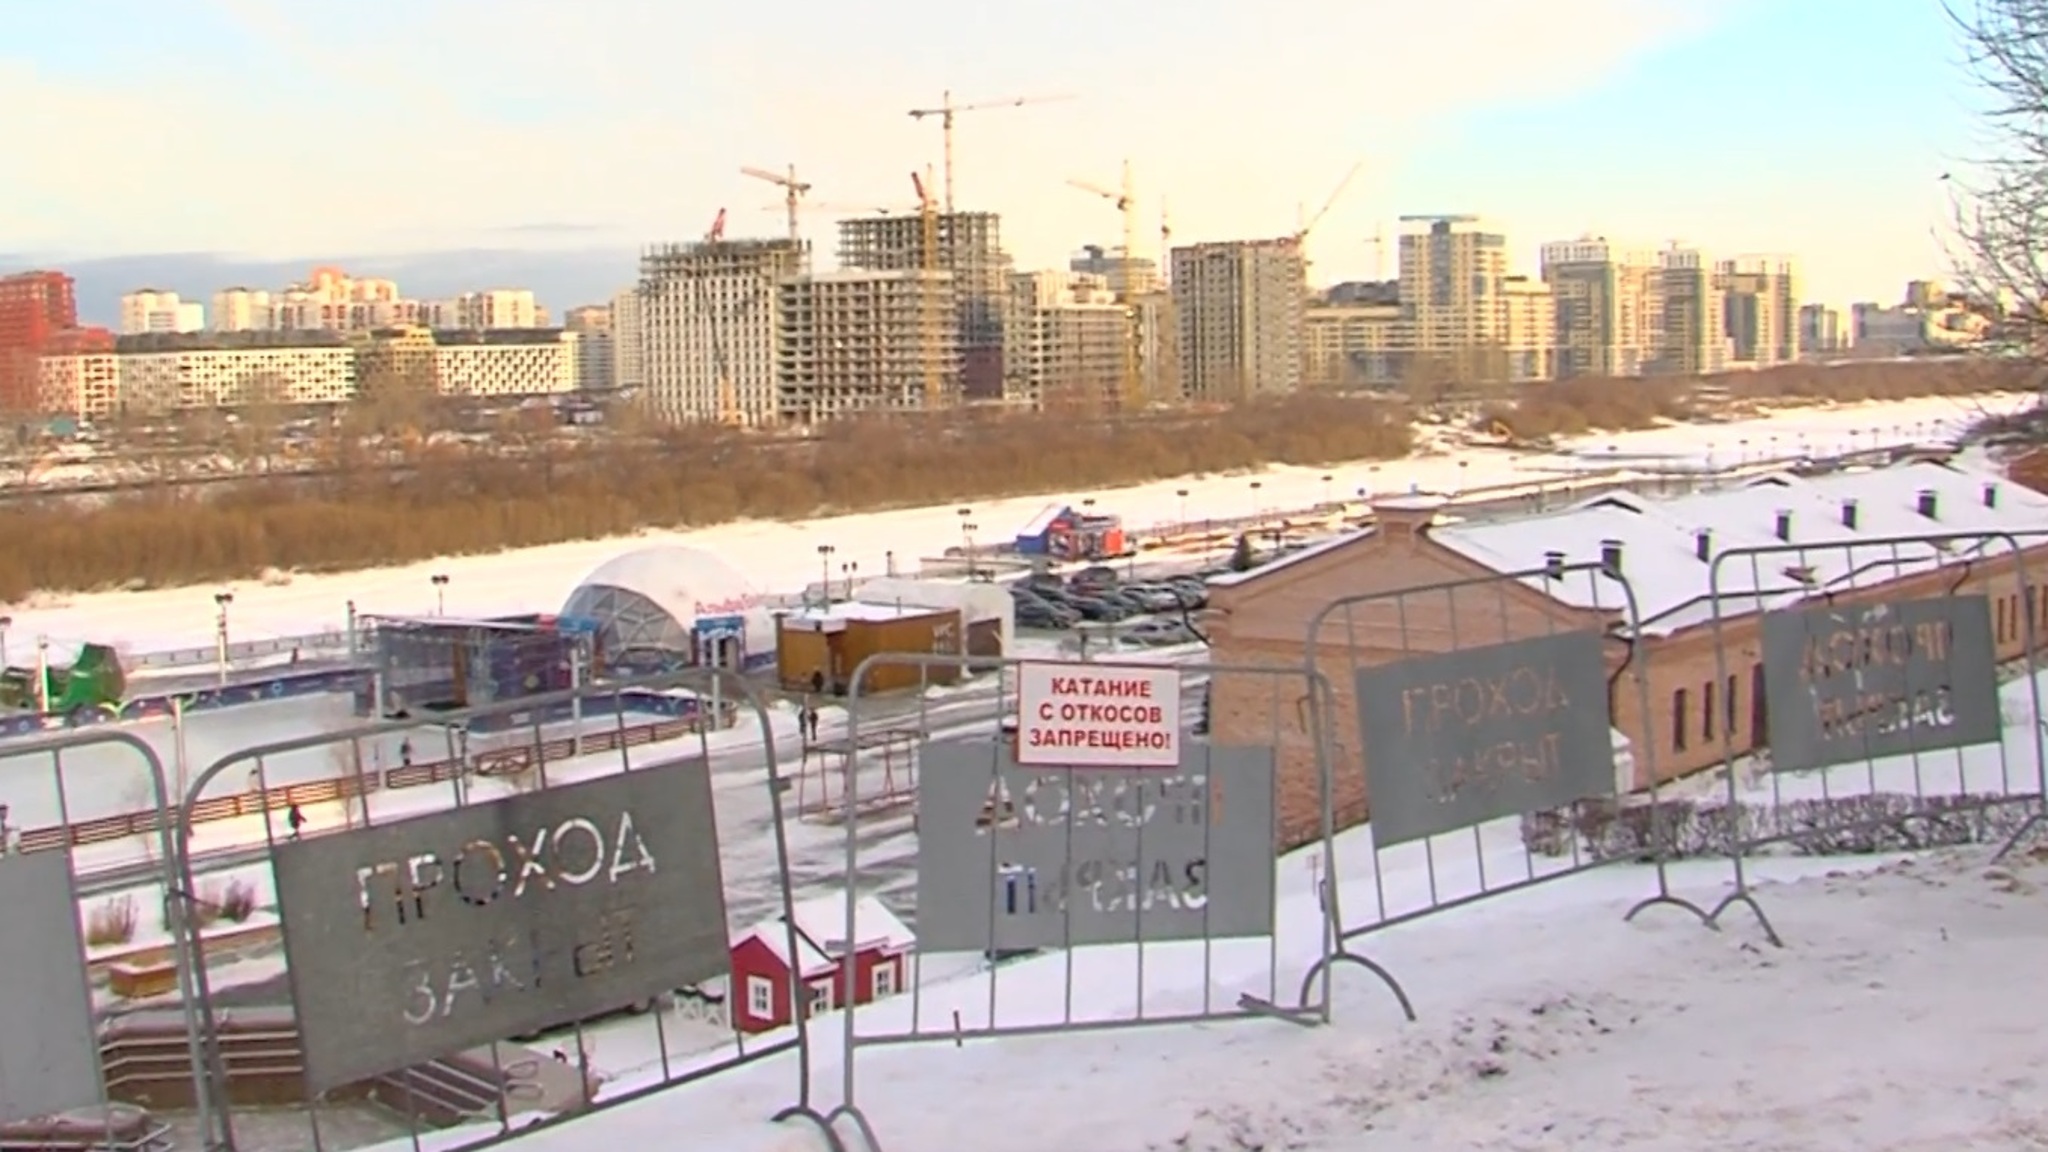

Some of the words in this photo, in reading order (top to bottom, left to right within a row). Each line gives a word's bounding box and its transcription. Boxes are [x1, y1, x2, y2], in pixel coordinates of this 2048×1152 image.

[1051, 677, 1152, 698] КАТАНИЕ
[1039, 703, 1053, 720] С
[1061, 704, 1162, 723] ОТКОСОВ
[1030, 728, 1171, 750] ЗАПРЕЩЕНО!
[356, 810, 656, 931] ПРОХОД
